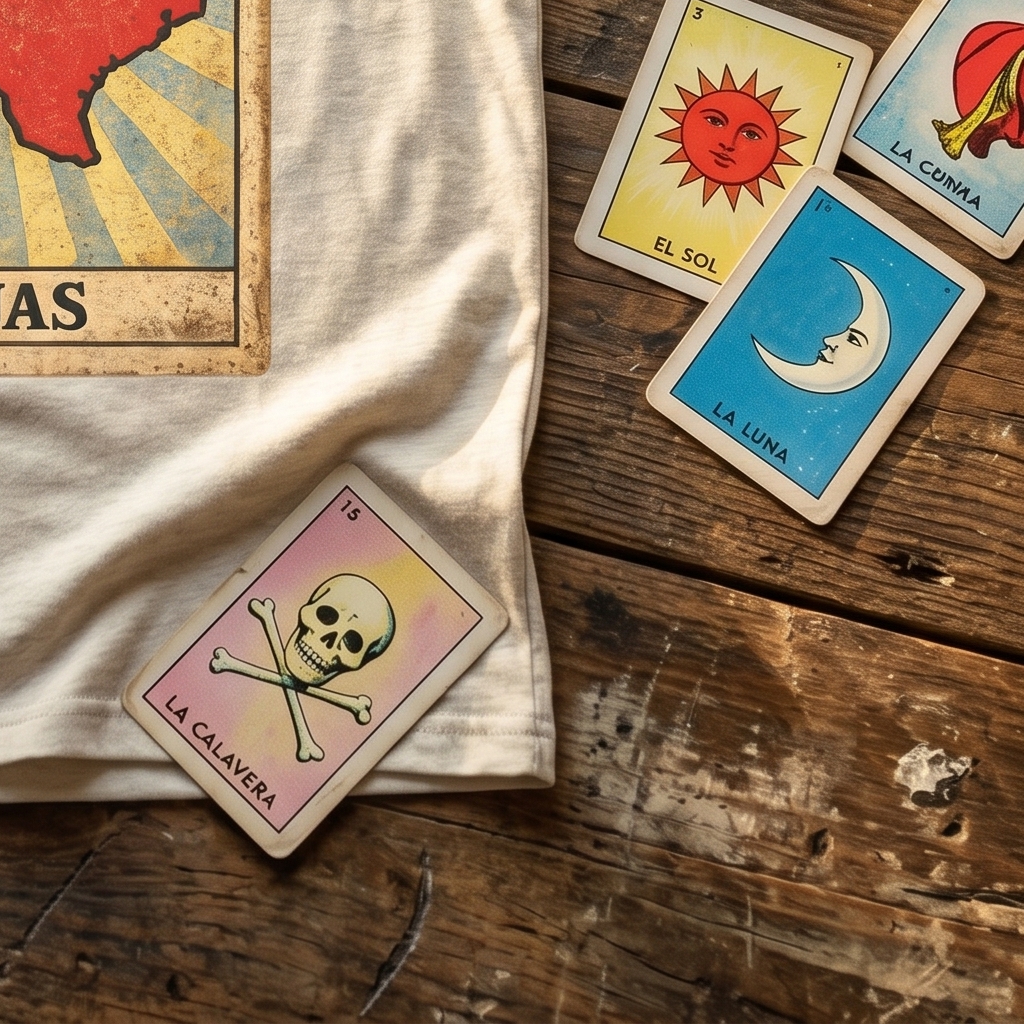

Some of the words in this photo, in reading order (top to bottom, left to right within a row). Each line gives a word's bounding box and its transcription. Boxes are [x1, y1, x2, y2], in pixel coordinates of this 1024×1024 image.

[692, 6, 704, 20] 3
[889, 140, 913, 164] LA
[653, 235, 674, 257] EL
[681, 247, 717, 275] SOL
[712, 401, 736, 427] LA
[741, 421, 788, 465] LUNA
[340, 499, 361, 521] 15
[165, 694, 189, 725] LA
[191, 721, 277, 811] CALAVERA
